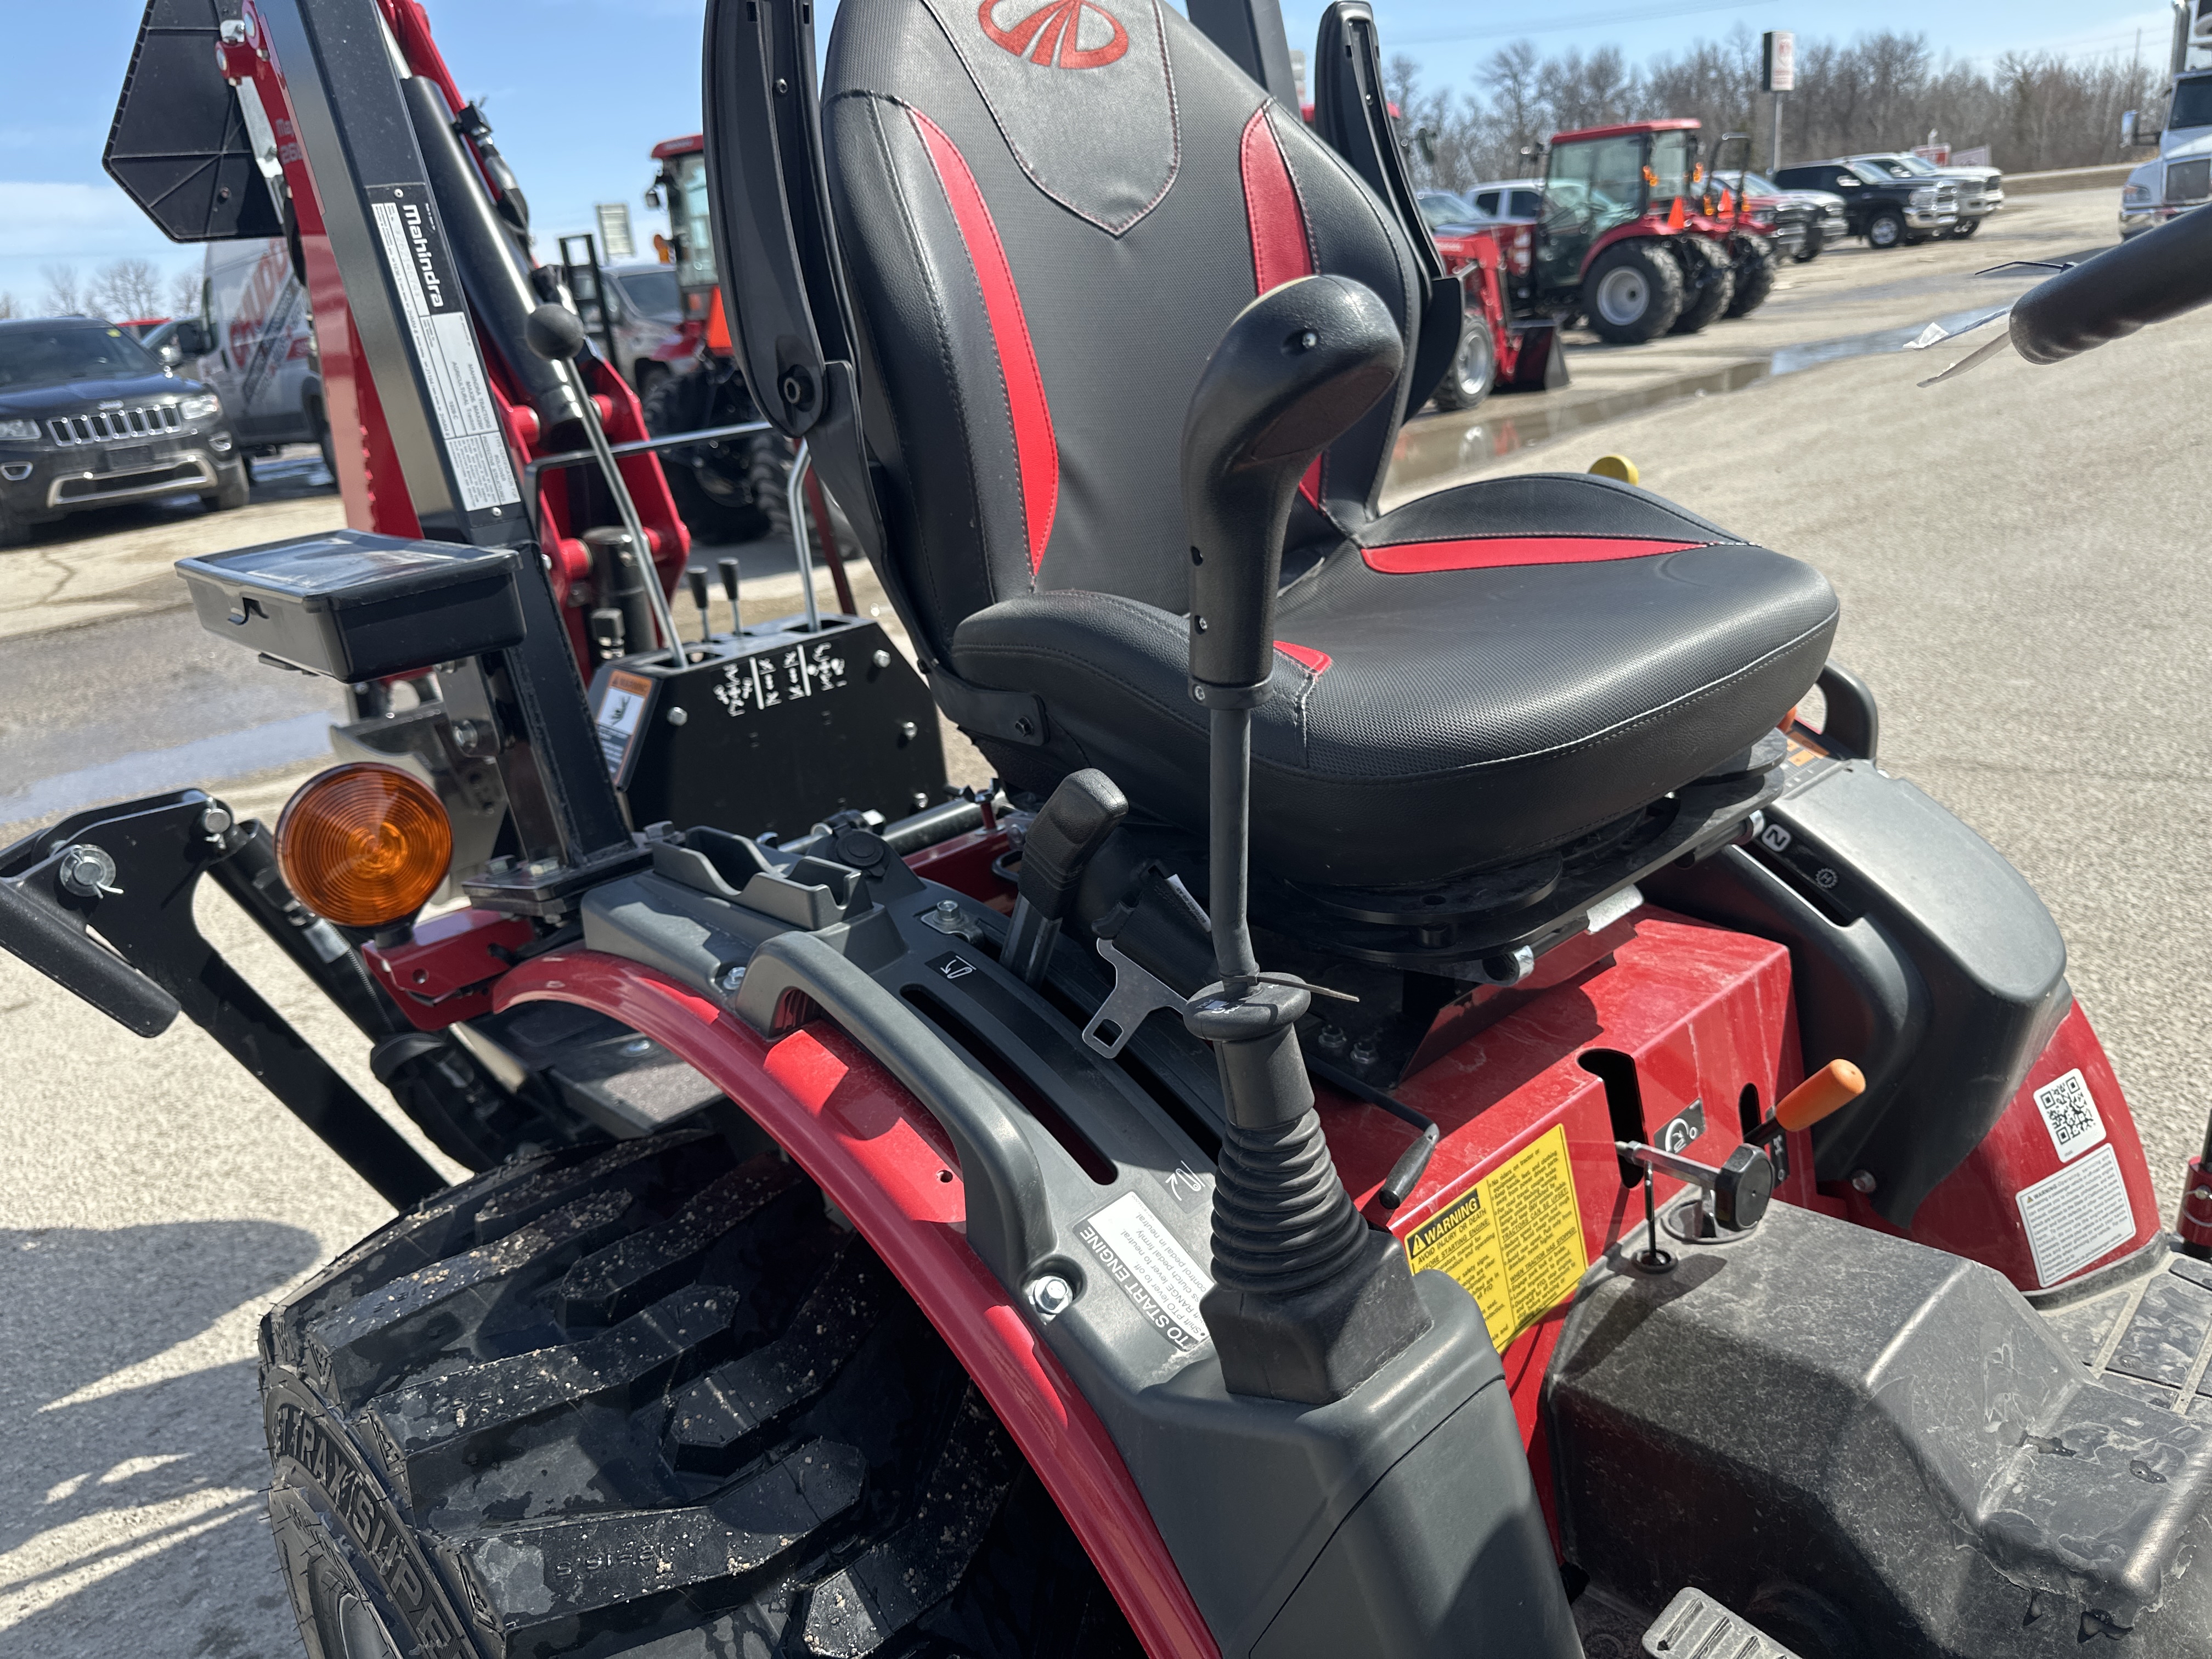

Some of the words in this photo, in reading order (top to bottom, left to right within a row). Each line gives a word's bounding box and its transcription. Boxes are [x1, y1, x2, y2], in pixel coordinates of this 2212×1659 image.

[402, 204, 444, 308] Mahindra
[1424, 1195, 1478, 1246] WARNING
[1502, 1216, 1528, 1242] TRACTORS
[1530, 1206, 1541, 1220] CAN
[1542, 1200, 1549, 1211] BE
[1156, 1238, 1167, 1247] in
[1417, 1246, 1435, 1265] AVOID
[1436, 1229, 1457, 1250] INJURY
[1458, 1221, 1467, 1233] OR
[1468, 1207, 1486, 1226] DEATH
[1441, 1233, 1468, 1258] STARTING
[1077, 1226, 1132, 1282] ENGINE
[1143, 1256, 1152, 1264] to
[1152, 1249, 1174, 1272] pedal
[1164, 1245, 1186, 1268] pedal
[1509, 1267, 1523, 1283] WHEN
[1524, 1250, 1545, 1271] TRACTOR
[1545, 1241, 1555, 1254] HAS
[1143, 1274, 1153, 1283] to
[1149, 1264, 1169, 1284] lever
[1170, 1271, 1192, 1294] clutch
[1182, 1266, 1206, 1294] control
[1123, 1279, 1171, 1329] START
[1149, 1282, 1170, 1303] lever
[1165, 1282, 1194, 1313] RANGE
[1166, 1301, 1184, 1321] PTO
[1165, 1323, 1190, 1348] TO
[1183, 1317, 1201, 1335] Shift
[353, 1488, 466, 1658] SUPE
